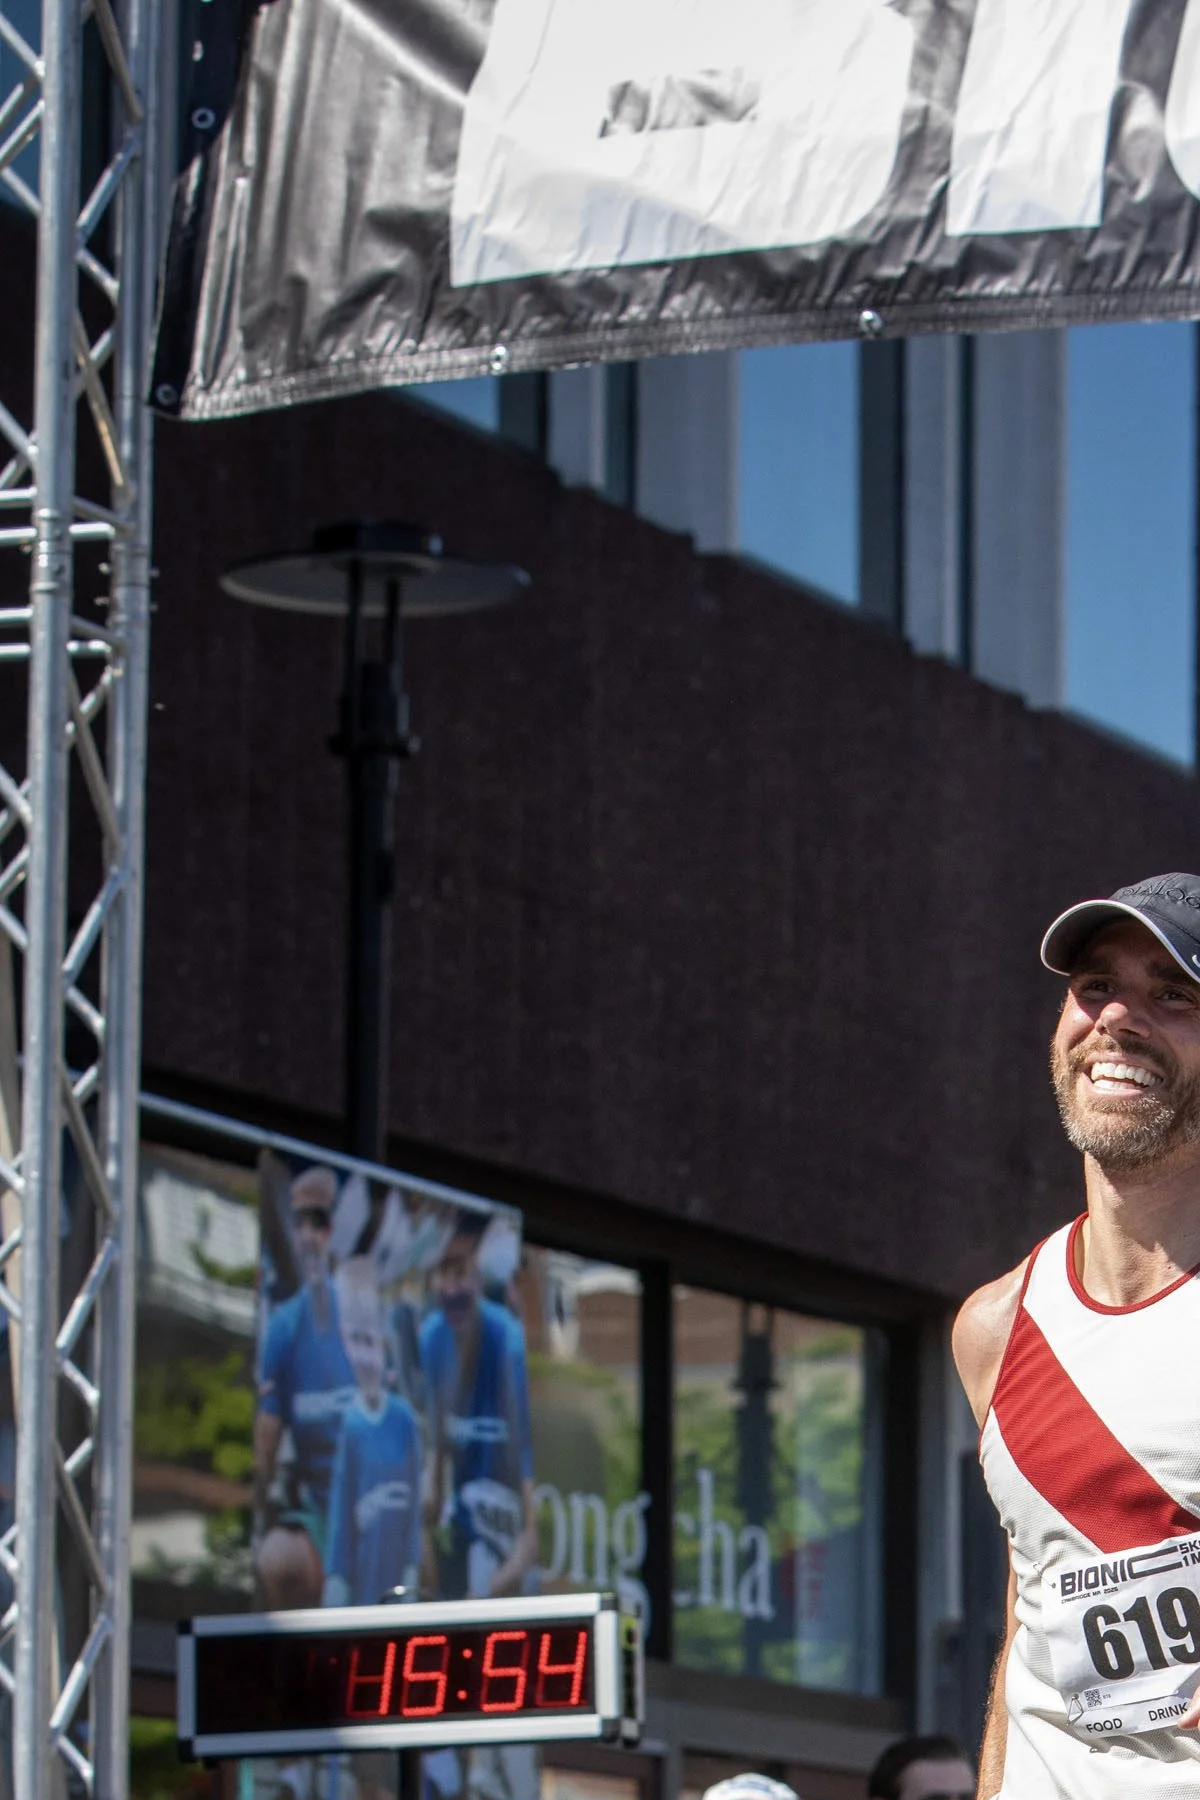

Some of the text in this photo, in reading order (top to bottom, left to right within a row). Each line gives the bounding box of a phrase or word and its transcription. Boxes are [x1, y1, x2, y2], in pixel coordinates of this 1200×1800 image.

[1060, 1545, 1183, 1597] BIONIC
[1148, 1702, 1188, 1721] DRINK
[1086, 1718, 1123, 1733] FOOD
